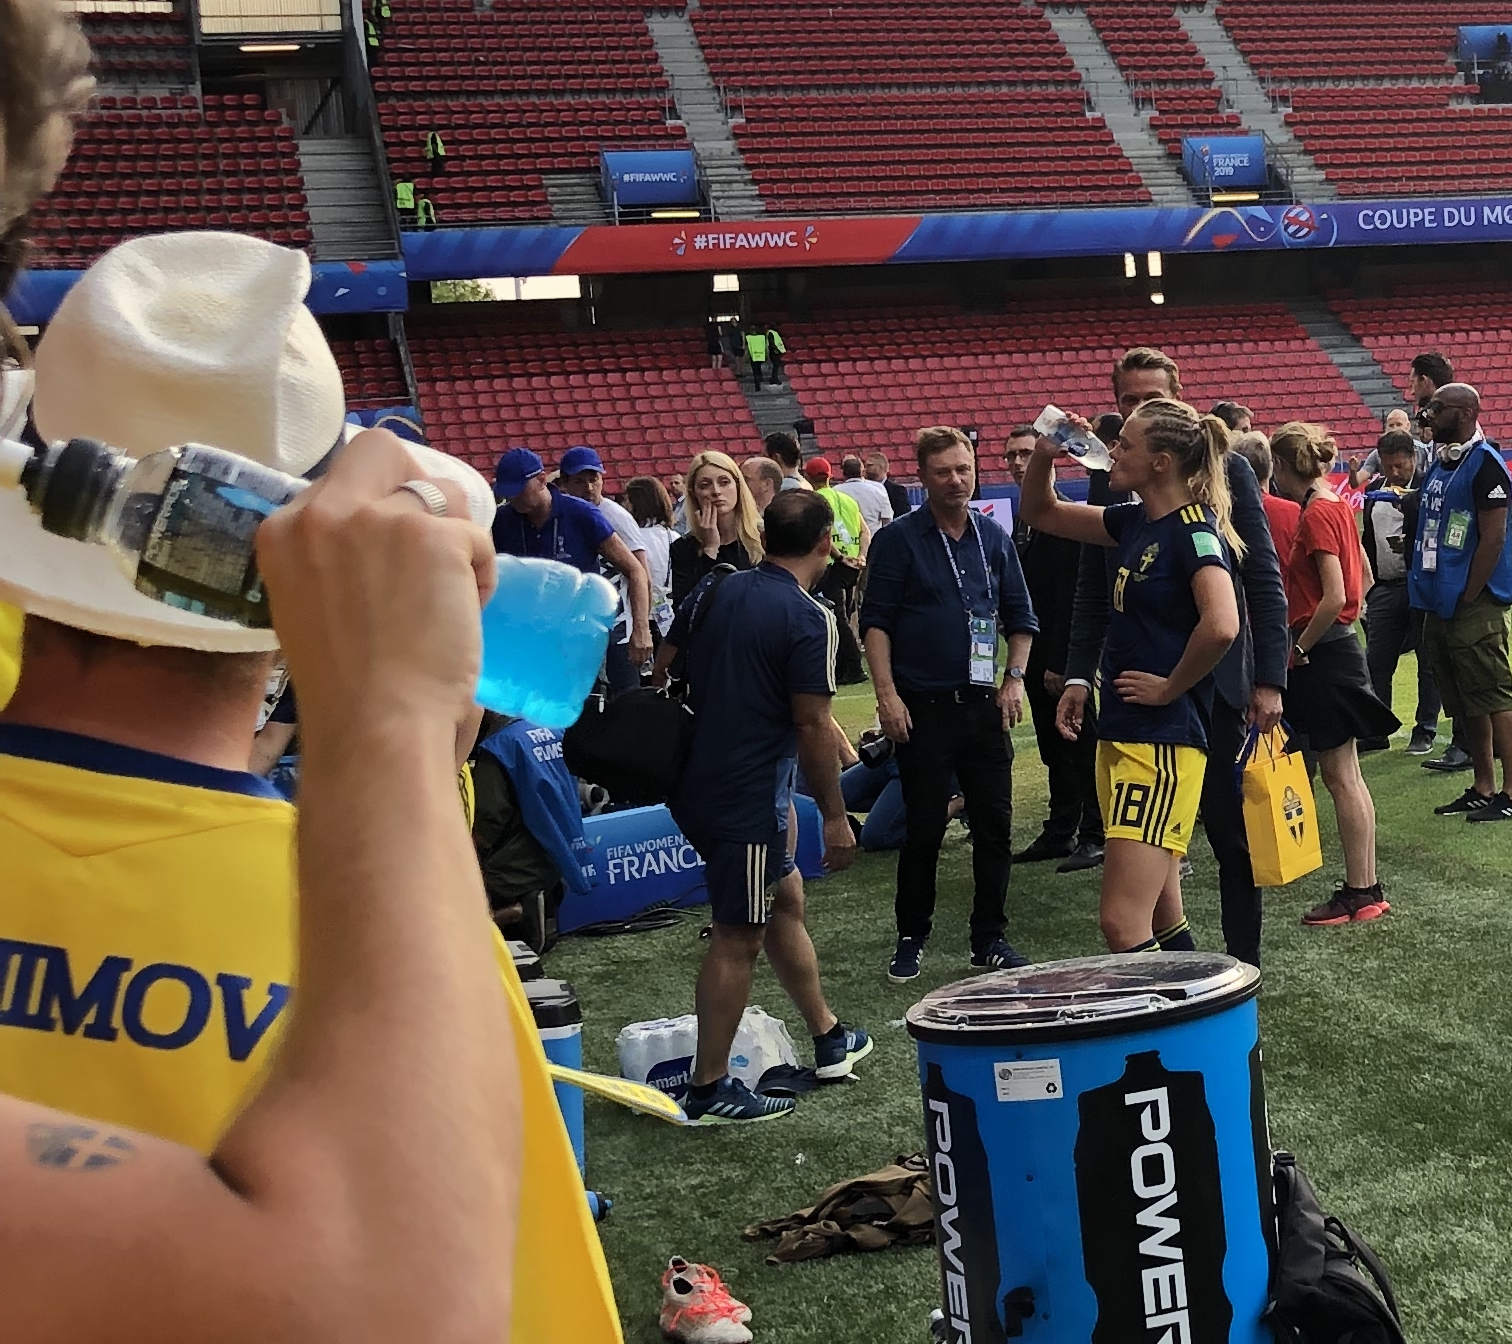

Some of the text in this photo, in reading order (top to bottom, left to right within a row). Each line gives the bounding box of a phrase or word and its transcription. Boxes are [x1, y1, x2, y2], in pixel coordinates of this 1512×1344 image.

[1212, 156, 1251, 168] FRANCE
[623, 171, 678, 183] #FIFAWWC
[1213, 166, 1234, 177] 2019
[1358, 207, 1438, 230] COUPE
[1444, 206, 1476, 228] DU
[693, 230, 799, 251] #FIFAWWC
[526, 727, 556, 744] FIFA
[1111, 781, 1151, 828] 18
[606, 845, 633, 860] FIFA
[0, 937, 291, 1062] IMOV
